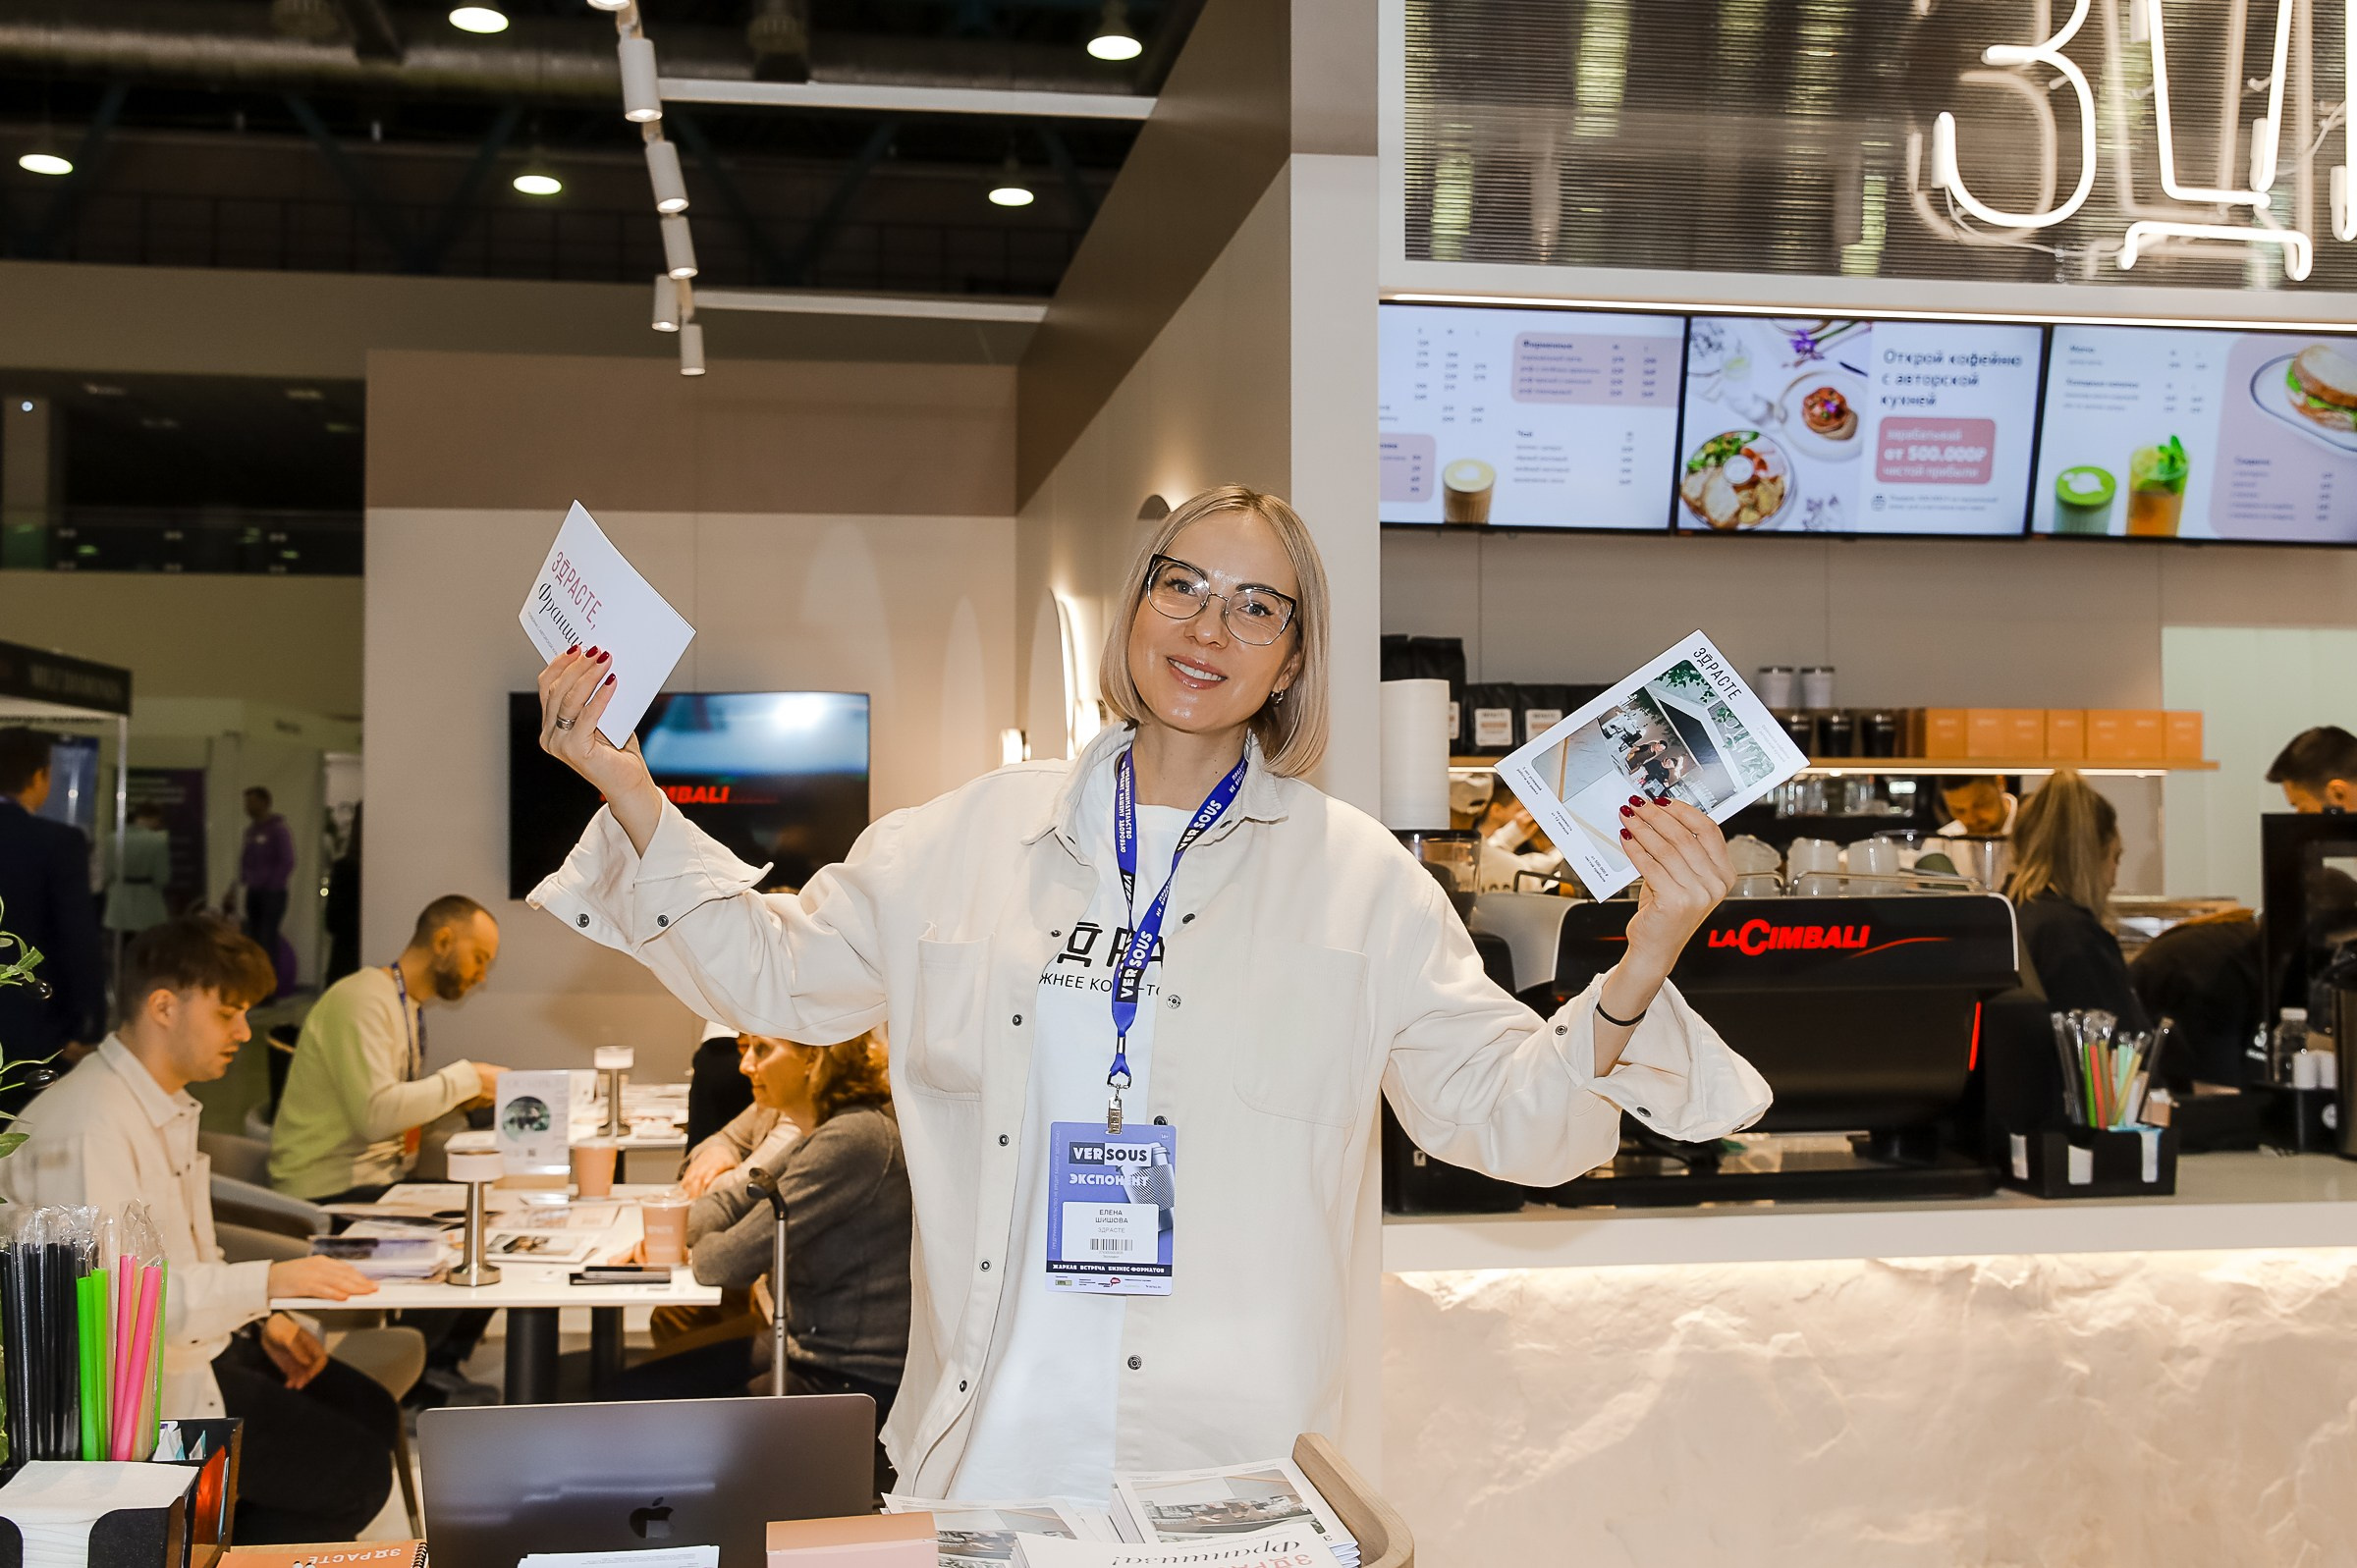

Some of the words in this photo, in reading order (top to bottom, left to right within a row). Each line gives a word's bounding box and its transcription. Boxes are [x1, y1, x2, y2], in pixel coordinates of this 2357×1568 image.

[1931, 0, 2357, 281] ЗД
[1884, 349, 1944, 365] Открой
[1950, 351, 2022, 367] кофейню
[1895, 372, 1979, 387] авторской
[1881, 393, 1937, 409] кухней
[1884, 448, 1904, 460] от
[1883, 465, 1924, 477] чистой
[1927, 466, 1979, 479] прибыли
[1693, 647, 1742, 701] ЗДРАСТЕ
[1178, 799, 1222, 851] VERSOUS
[1121, 931, 1152, 998] VERSOUS
[1072, 1147, 1147, 1162] VERSOUS
[1069, 1173, 1151, 1187] ЭКСПОНЕНТ
[1112, 1541, 1300, 1566] Франшиза!
